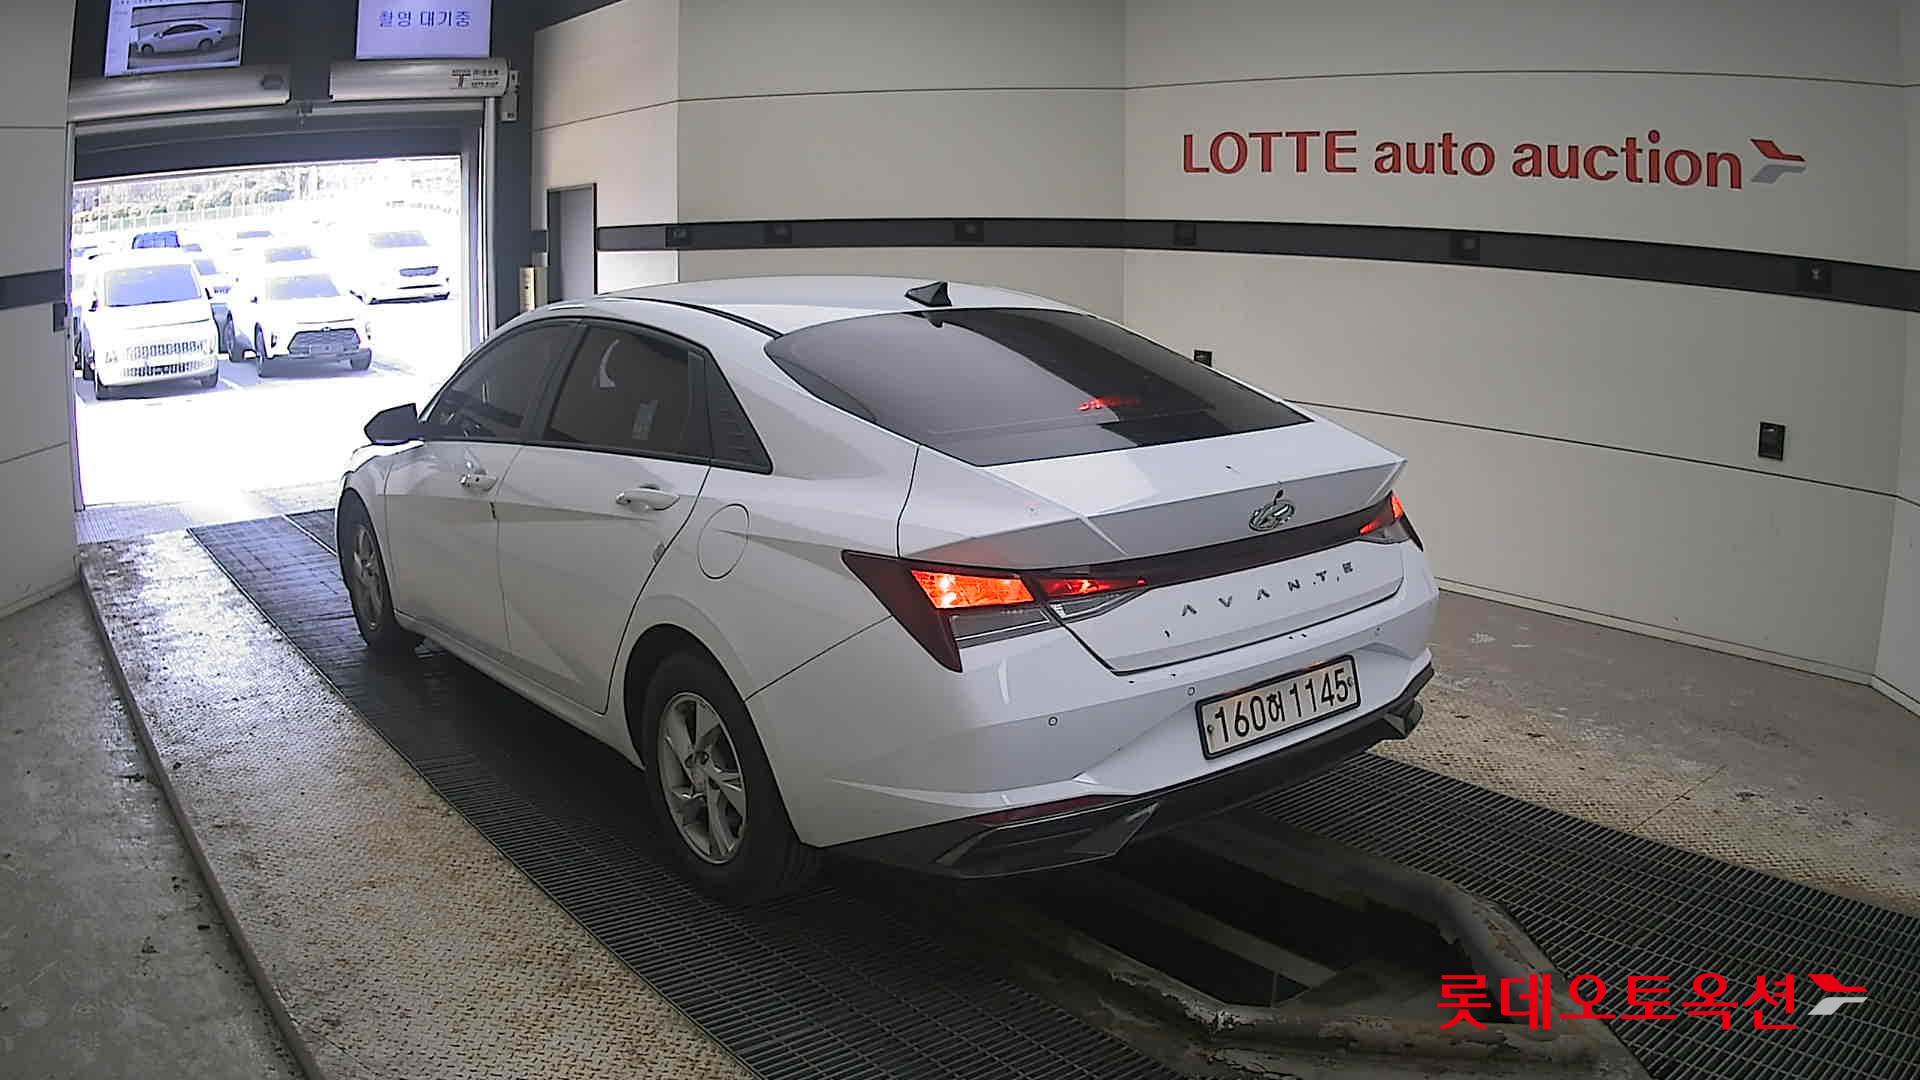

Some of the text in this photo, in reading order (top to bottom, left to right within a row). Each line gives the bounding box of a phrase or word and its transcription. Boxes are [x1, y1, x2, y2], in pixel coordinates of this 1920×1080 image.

[420, 10, 471, 28] 대기중
[1184, 129, 1742, 189] LOTTE auto auction
[1181, 561, 1353, 617] AVANTE
[1215, 667, 1349, 743] 160허 1145
